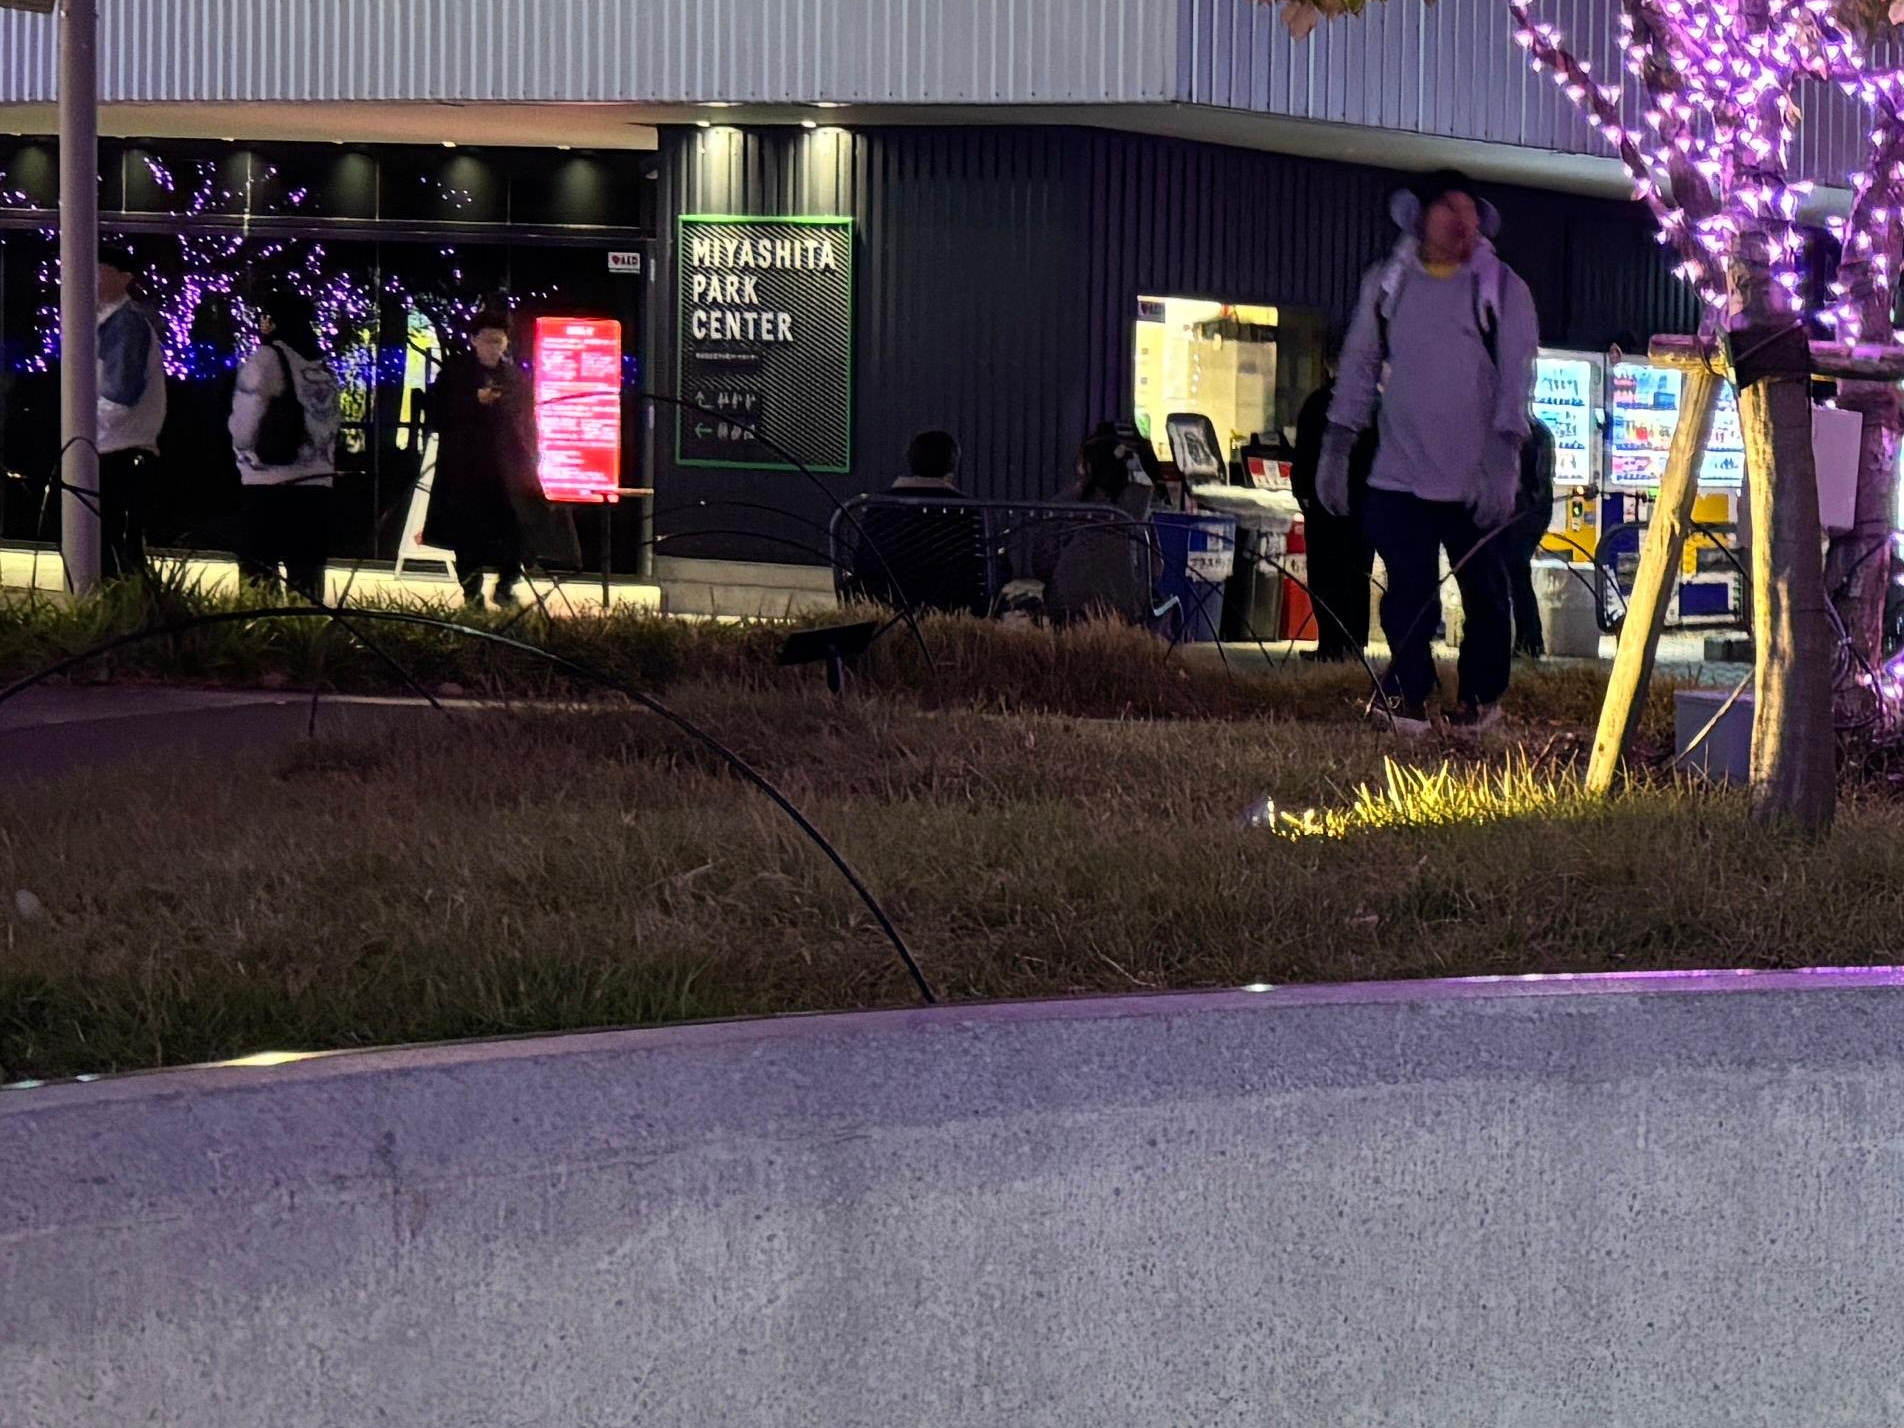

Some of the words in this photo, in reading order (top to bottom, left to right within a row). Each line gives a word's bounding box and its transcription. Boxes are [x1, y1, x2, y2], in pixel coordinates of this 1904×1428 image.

[692, 237, 836, 270] MIYASHITA
[692, 274, 759, 304] PARK
[692, 309, 794, 341] CENTER
